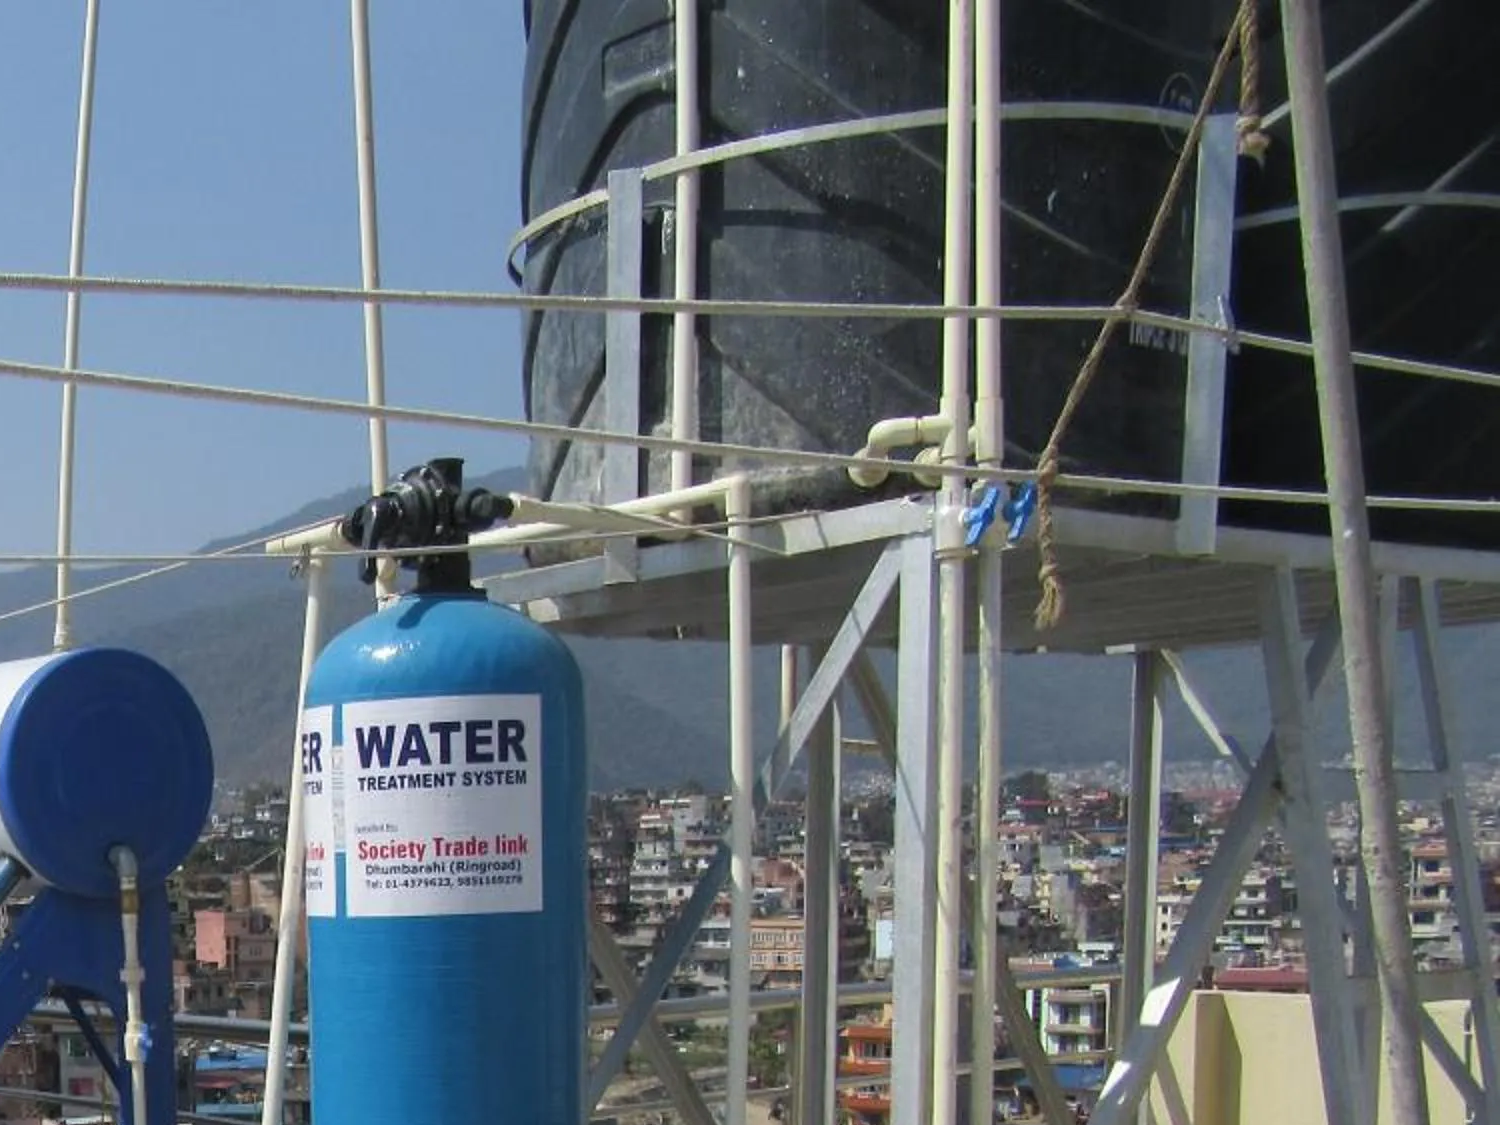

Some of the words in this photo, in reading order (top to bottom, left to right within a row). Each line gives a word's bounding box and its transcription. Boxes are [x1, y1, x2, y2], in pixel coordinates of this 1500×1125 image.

[356, 719, 528, 769] WATER
[357, 772, 457, 792] TREATMENT
[462, 769, 528, 787] SYSTEM
[357, 838, 427, 862] Society
[432, 835, 489, 858] Trade
[495, 833, 529, 856] link
[365, 862, 445, 875] Dhumbarahi
[449, 859, 522, 876] (Ringroad)
